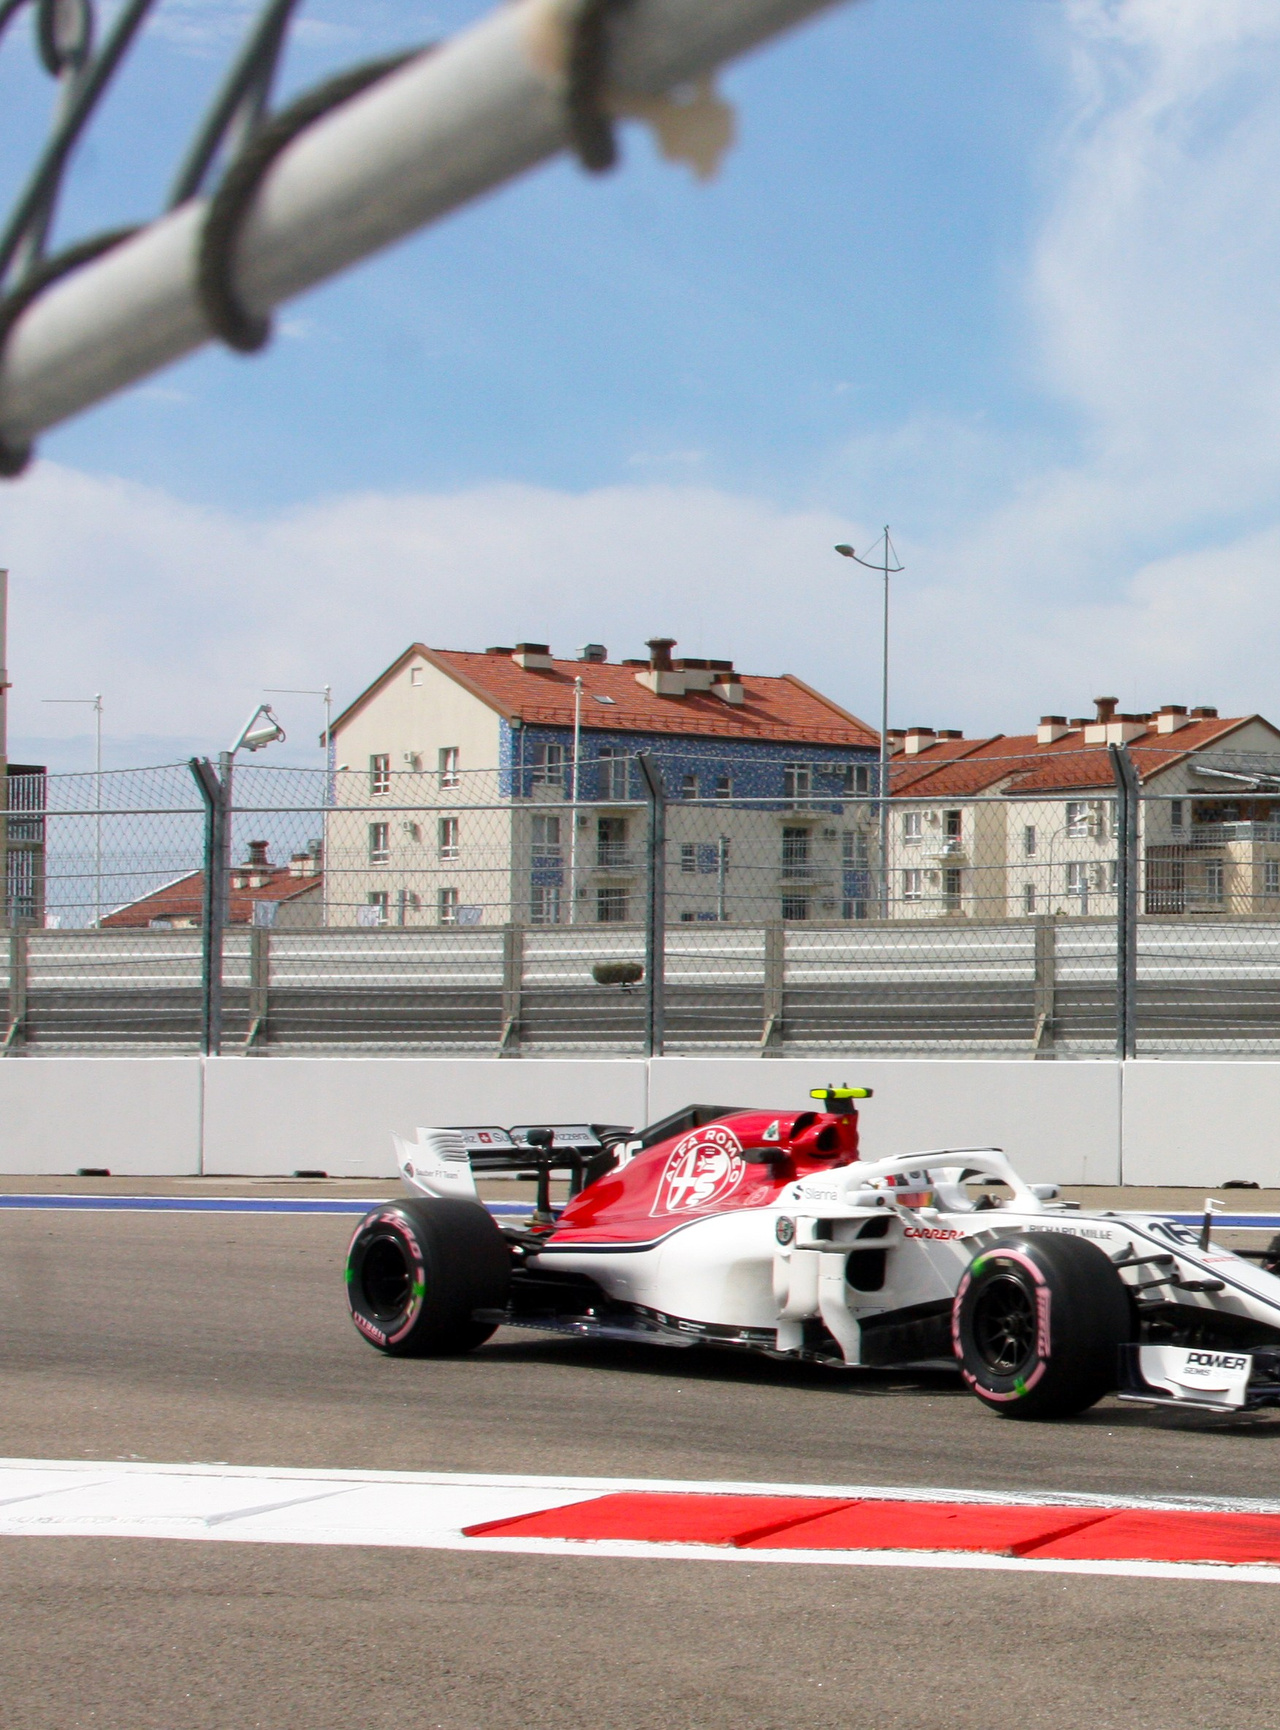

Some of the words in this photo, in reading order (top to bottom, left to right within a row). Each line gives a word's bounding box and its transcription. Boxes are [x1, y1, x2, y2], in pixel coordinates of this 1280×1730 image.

[665, 1136, 699, 1183] ALFA
[704, 1130, 742, 1183] ROMEO
[903, 1227, 966, 1240] CARRERA
[1148, 1221, 1202, 1246] 16
[352, 1310, 387, 1346] PIRELLI
[1186, 1352, 1248, 1370] POWER
